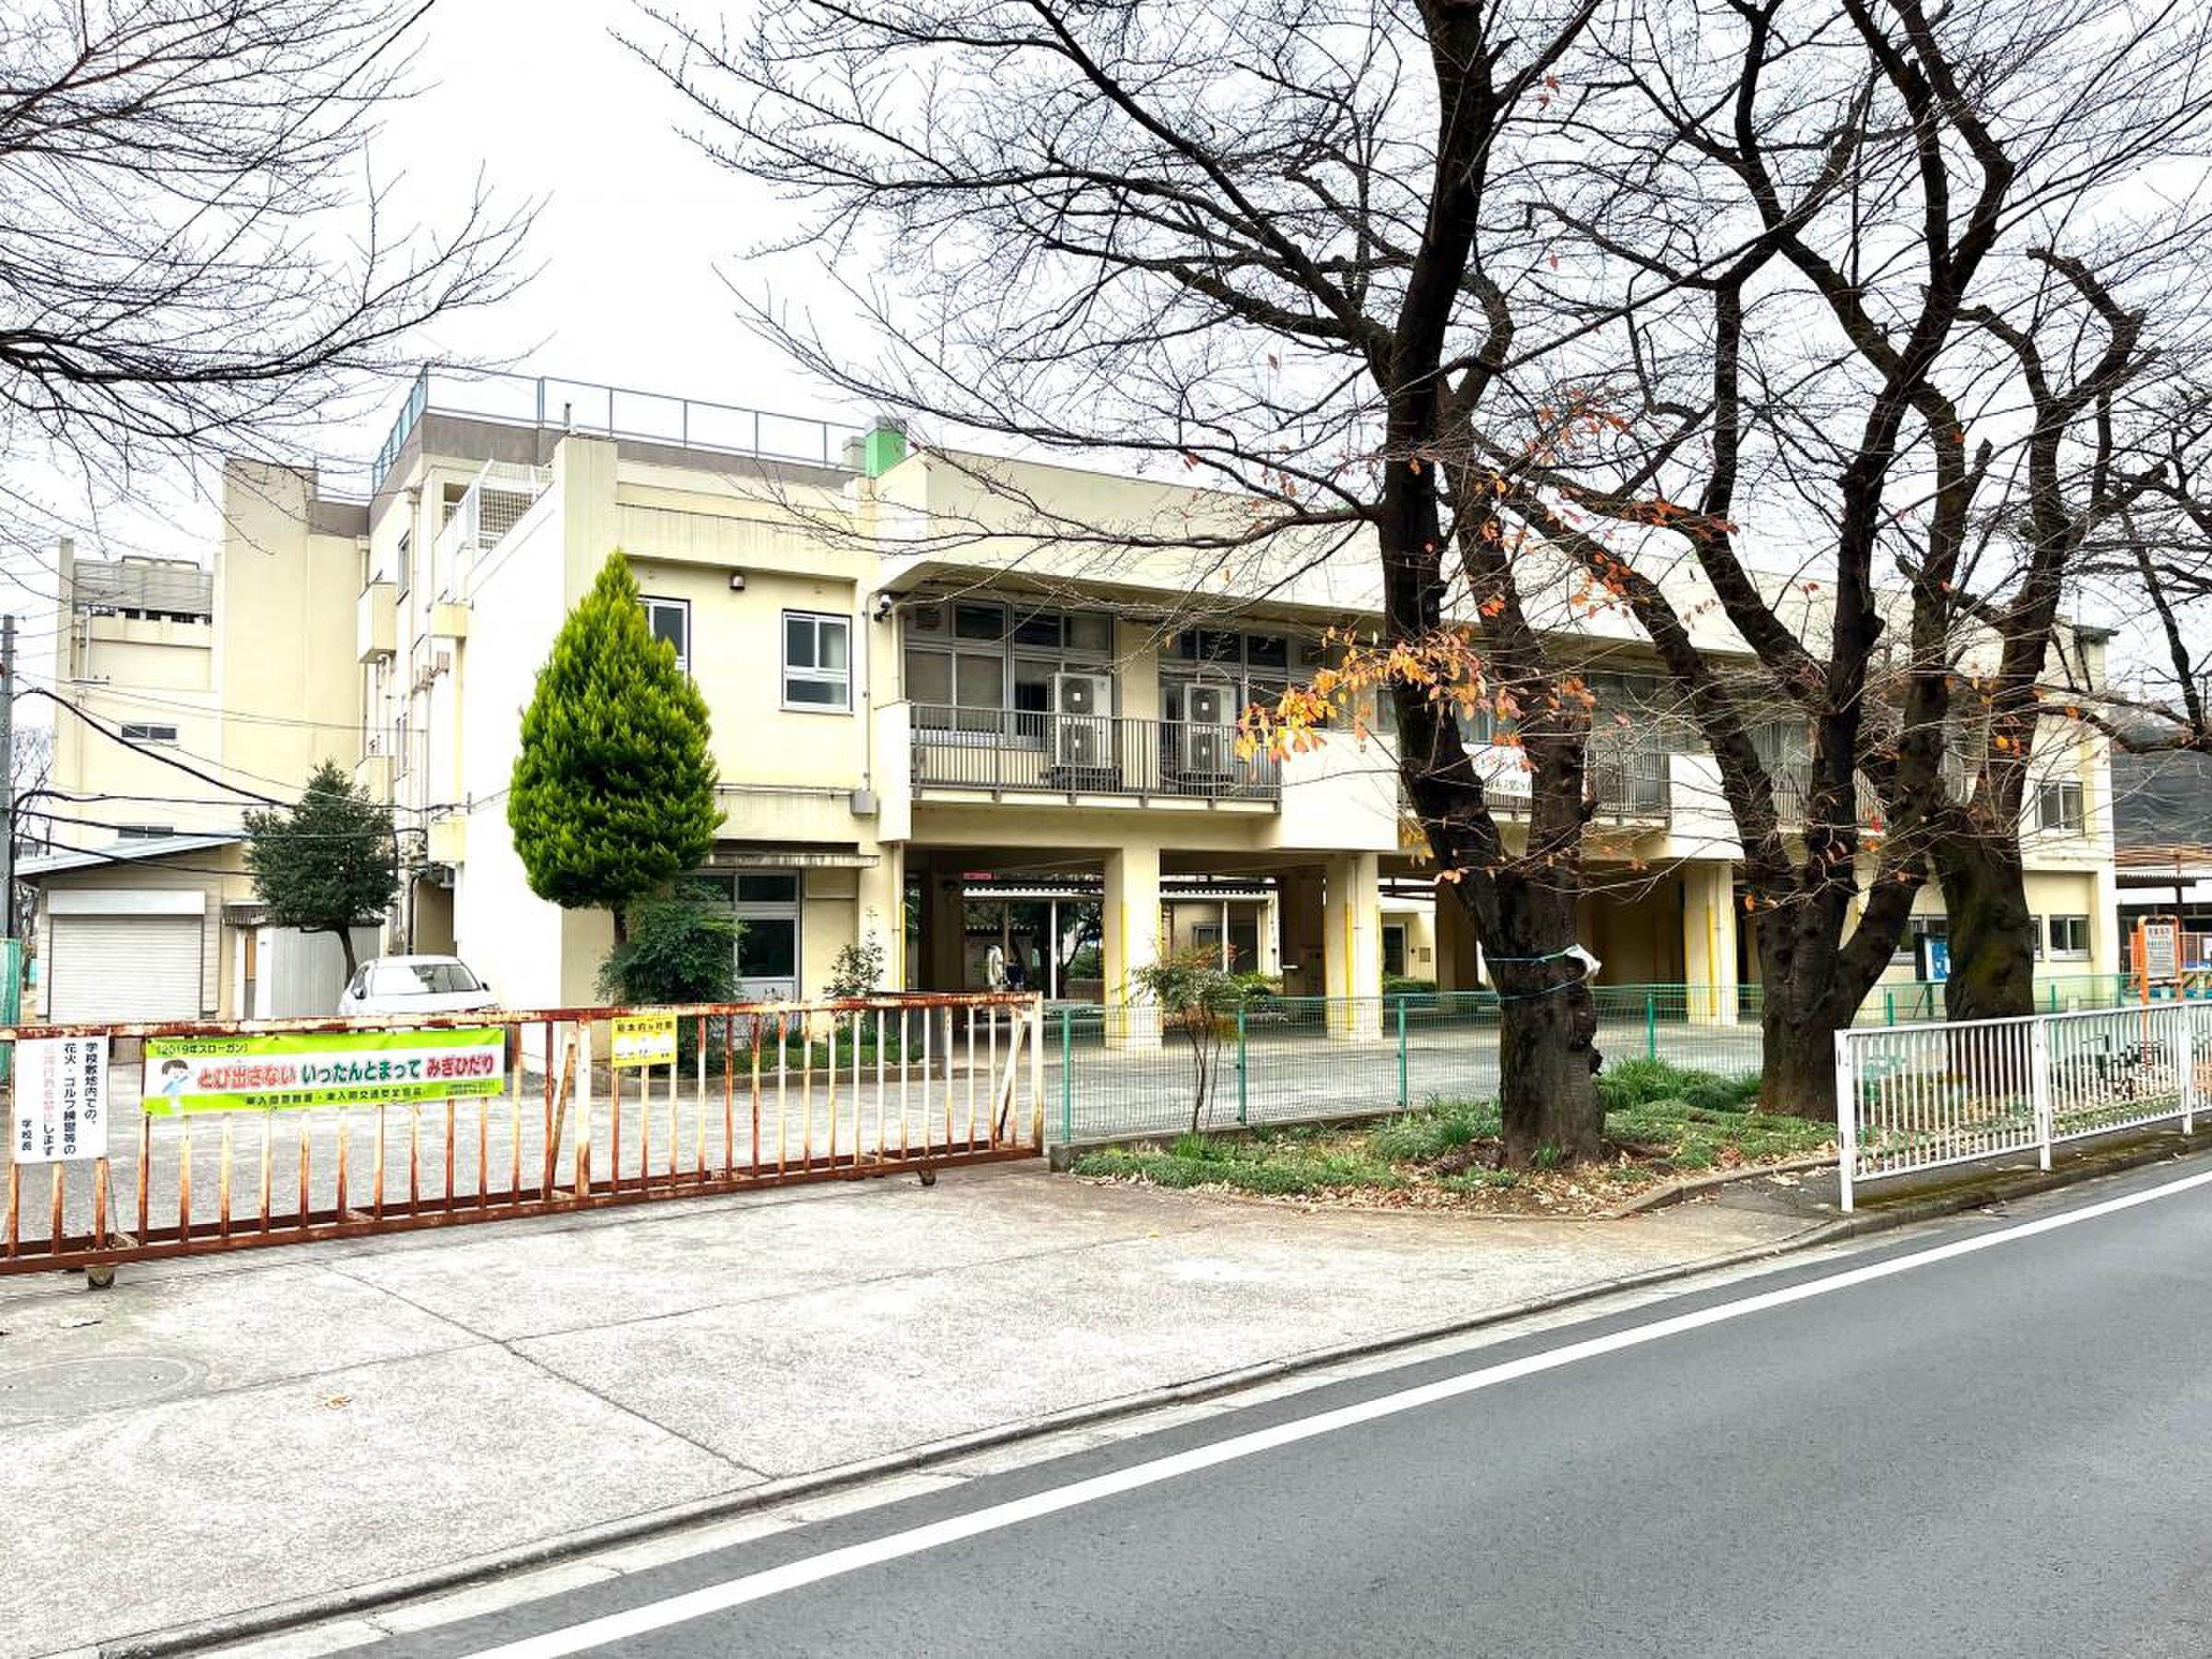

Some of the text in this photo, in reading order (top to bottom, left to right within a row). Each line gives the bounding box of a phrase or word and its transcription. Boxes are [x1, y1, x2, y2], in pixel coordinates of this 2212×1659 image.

[197, 1053, 494, 1089] とび出さない いったんとまって みぎひだり
